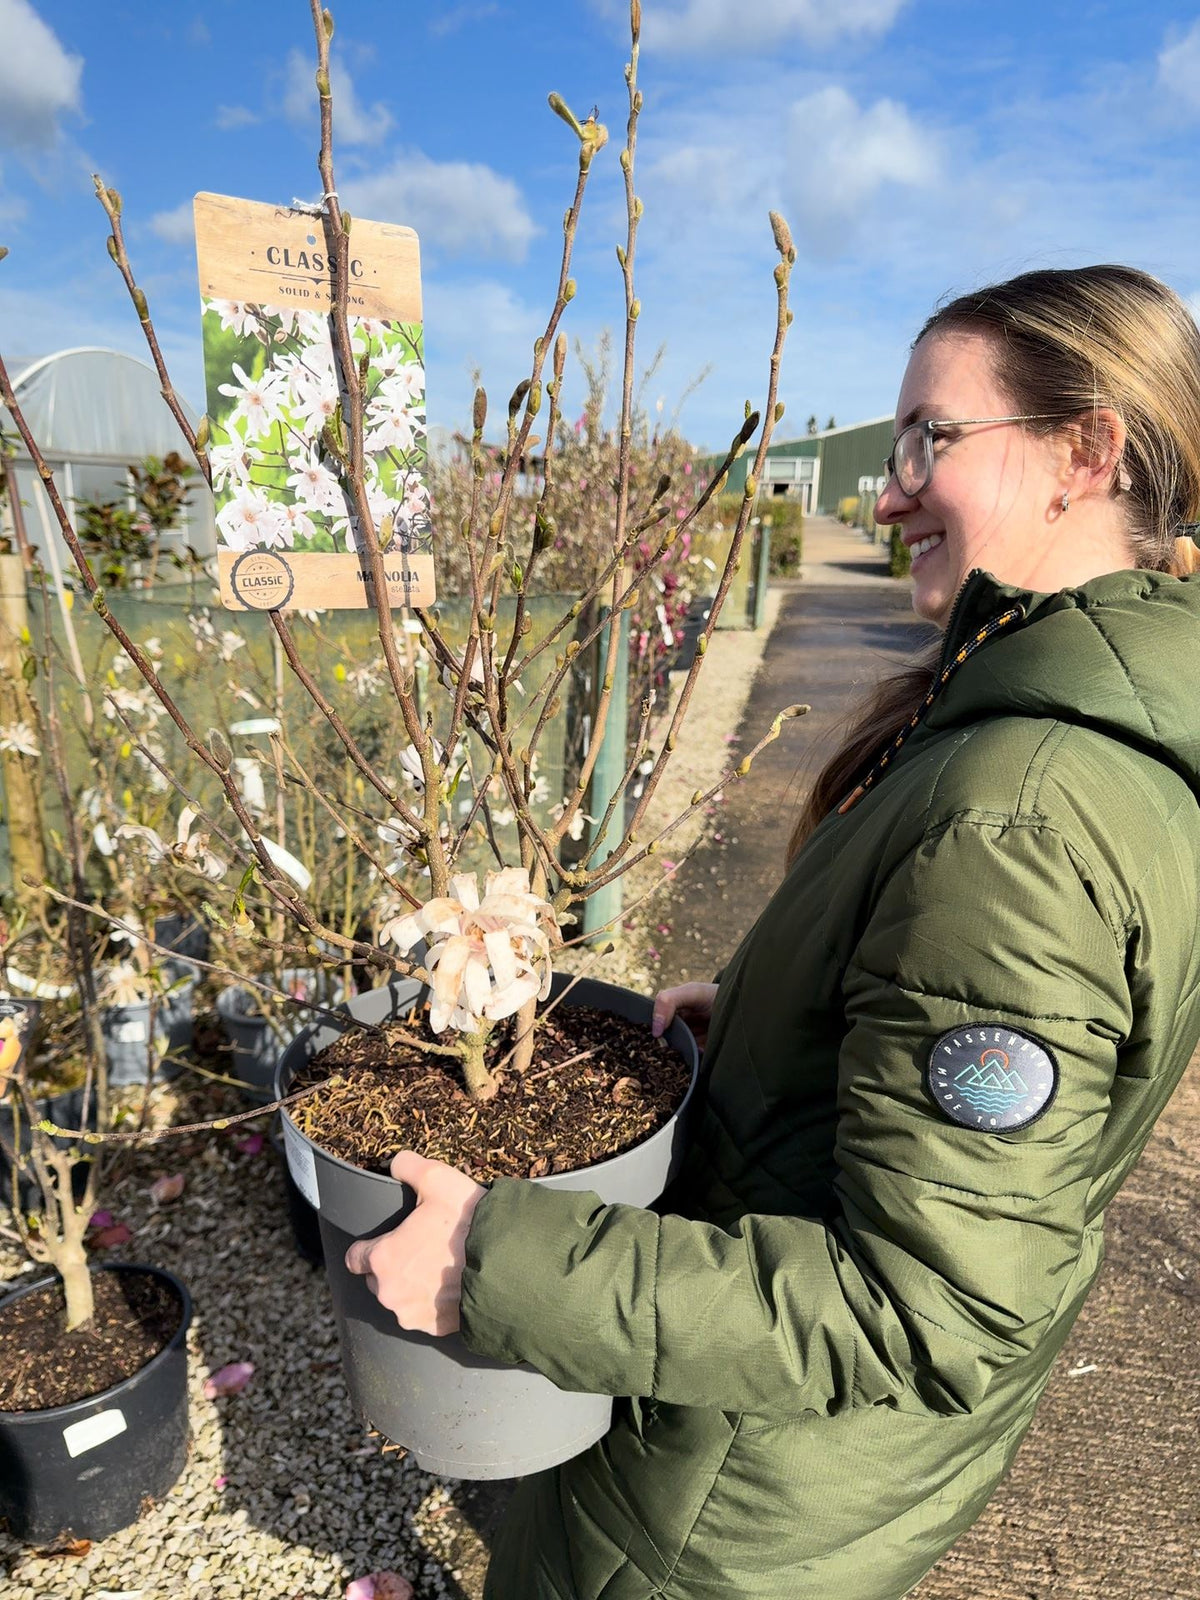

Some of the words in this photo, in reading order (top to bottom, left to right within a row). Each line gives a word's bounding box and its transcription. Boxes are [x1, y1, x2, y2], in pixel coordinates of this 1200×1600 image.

[266, 246, 364, 278] CLASSC
[279, 286, 310, 298] SOLID
[314, 291, 321, 300] &
[325, 293, 365, 305] STONG
[356, 571, 420, 582] MANOLIA
